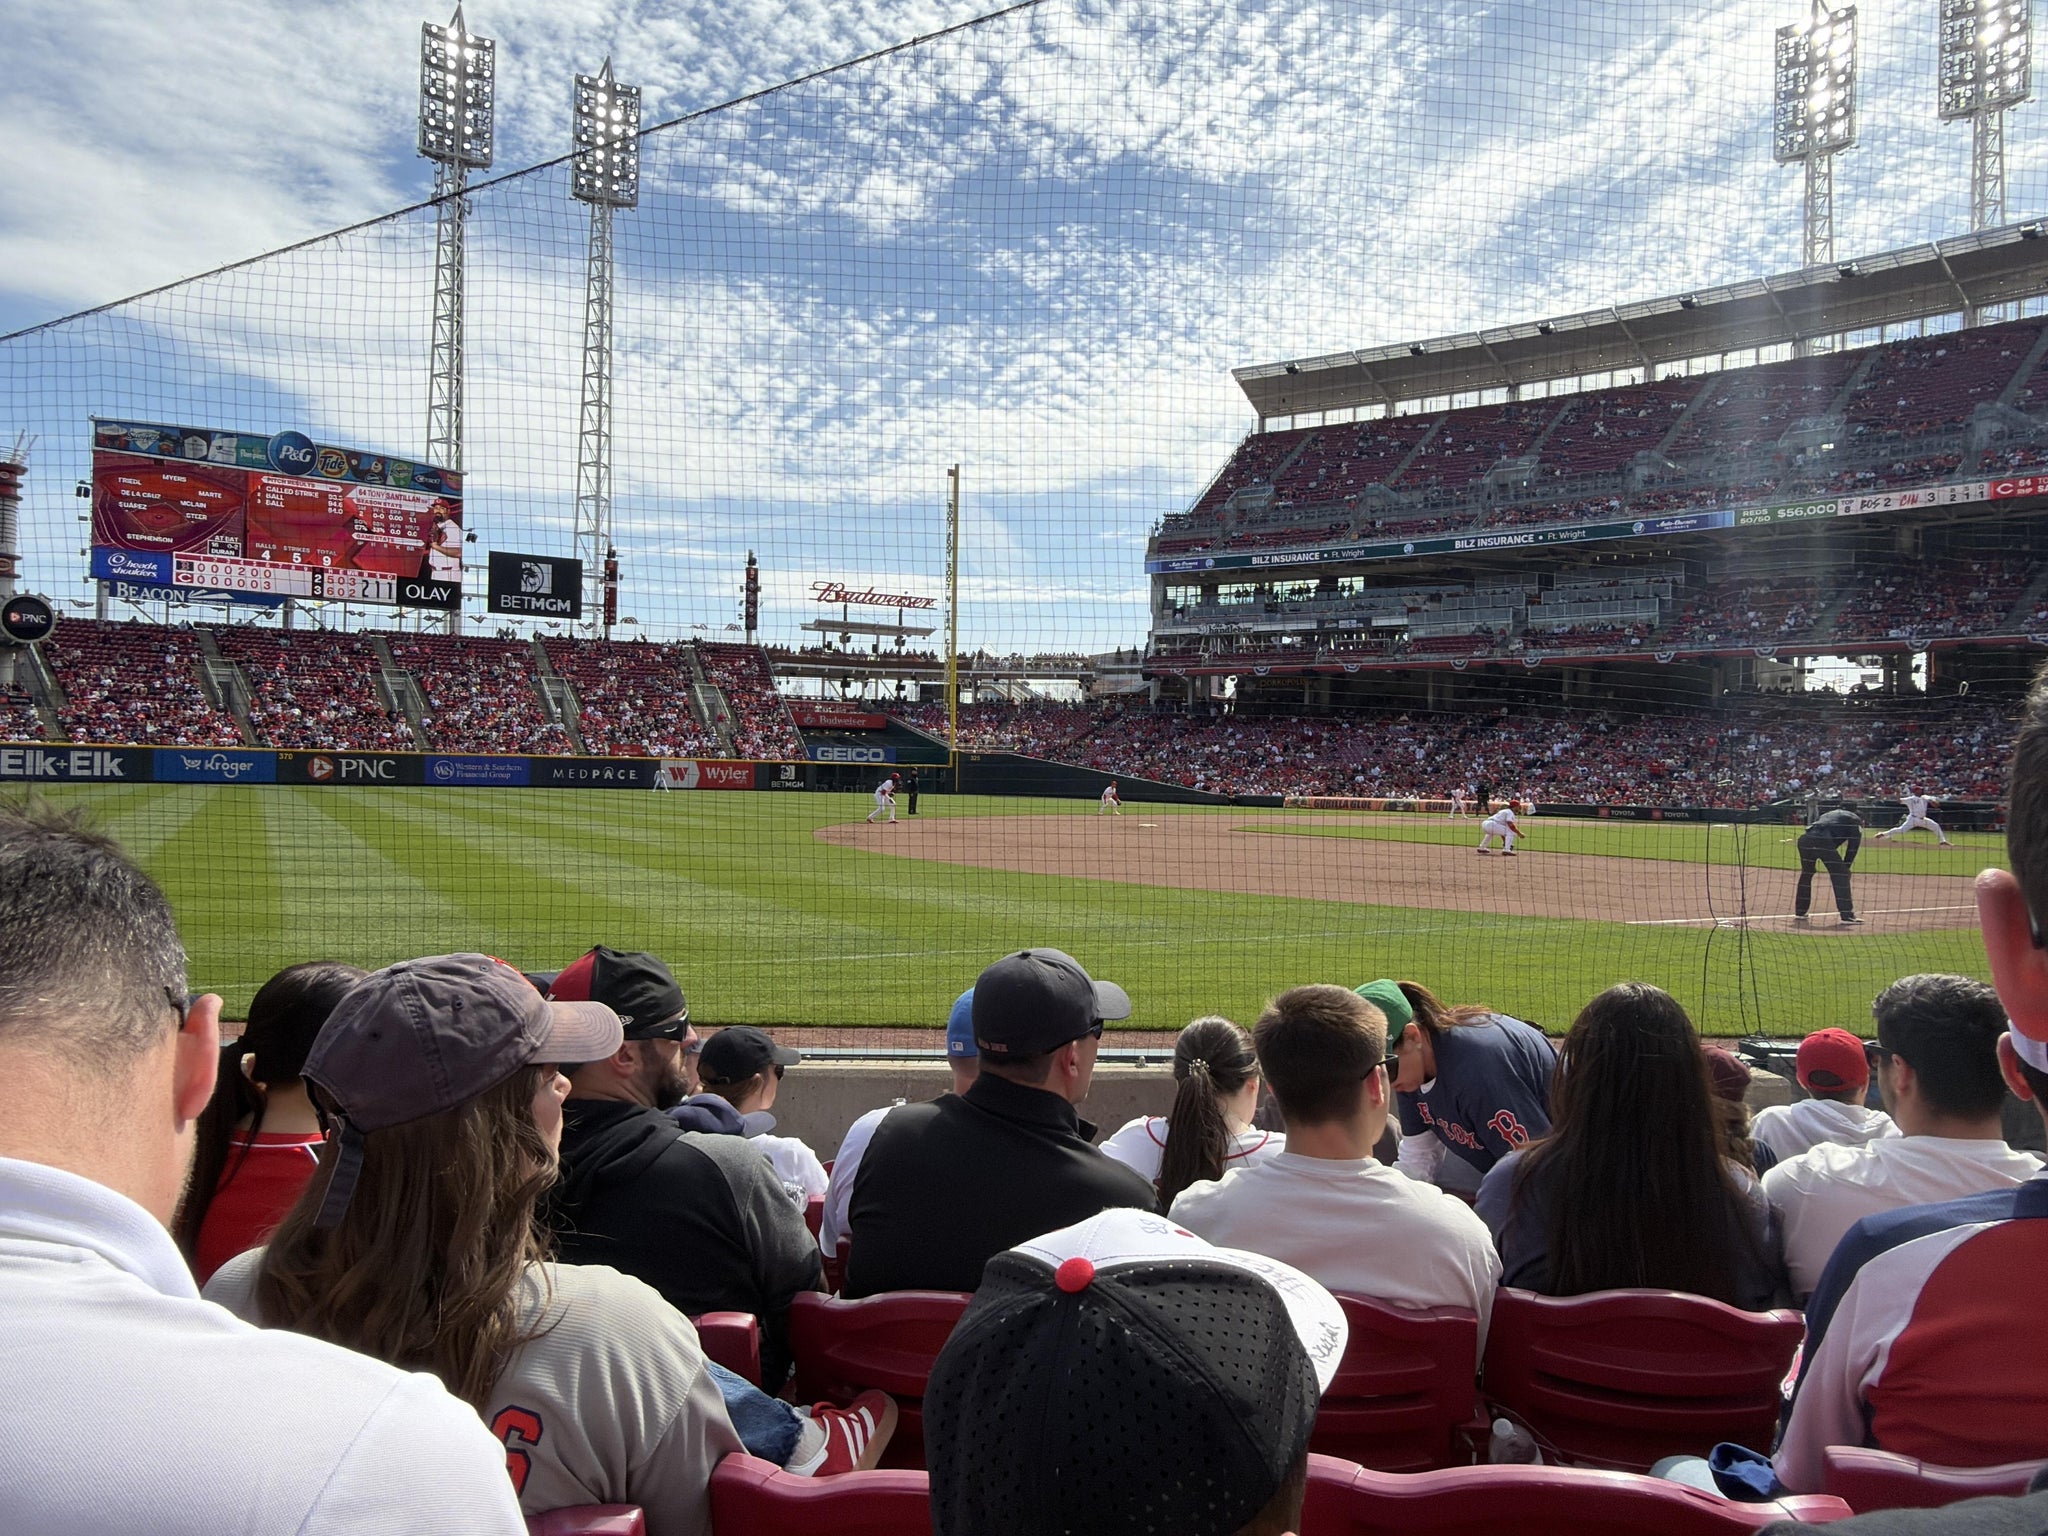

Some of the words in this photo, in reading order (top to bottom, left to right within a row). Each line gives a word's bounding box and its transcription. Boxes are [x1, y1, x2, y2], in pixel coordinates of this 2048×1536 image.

[279, 445, 313, 462] P&G
[320, 456, 345, 471] Tide
[162, 474, 187, 482] MYERS
[142, 492, 161, 500] CRUZ
[198, 490, 222, 499] MARTE
[266, 486, 294, 495] CALLED
[294, 490, 319, 498] STRIKE
[368, 490, 385, 498] TONY
[386, 492, 420, 504] SANTILLAN
[1950, 494, 1956, 502] 2
[1964, 492, 1970, 500] 1
[1980, 490, 1984, 498] 1
[266, 500, 284, 508] BALL
[1884, 498, 1892, 507] 2
[1900, 494, 1919, 506] CIN
[1928, 492, 1936, 502] 3
[1742, 508, 1768, 517] REDS
[1777, 504, 1836, 518] $56,000
[1844, 506, 1850, 514] 8
[1740, 516, 1771, 524] 50/50
[126, 533, 174, 543] STEPHENSON
[390, 528, 402, 536] 0.0
[1454, 540, 1476, 550] BILZ
[1477, 534, 1535, 548] INSURANCE
[1547, 532, 1557, 540] Ft.
[1560, 530, 1586, 540] Wright
[211, 548, 235, 556] DURAN
[261, 550, 271, 560] 4
[283, 546, 310, 554] STRIKES
[292, 552, 302, 563] 5
[322, 556, 332, 566] 9
[1252, 556, 1270, 564] BILZ
[1271, 552, 1320, 564] INSURANCE
[1342, 550, 1365, 558] Wright
[112, 566, 158, 578] shoulders
[198, 563, 206, 572] 0
[211, 564, 219, 574] 0
[224, 566, 232, 575] 0
[238, 567, 246, 576] 2
[250, 568, 258, 577] 0
[264, 569, 272, 578] 0
[314, 574, 322, 584] 2
[327, 576, 334, 584] 5
[338, 576, 345, 586] 0
[348, 577, 356, 587] 3
[116, 581, 186, 602] BEACON
[197, 575, 205, 584] 0
[210, 576, 218, 586] 0
[224, 577, 232, 586] 0
[238, 578, 246, 588] 0
[250, 580, 258, 589] 0
[264, 581, 271, 590] 3
[314, 585, 322, 595] 3
[326, 586, 334, 596] 6
[338, 588, 345, 597] 0
[348, 588, 356, 598] 2
[362, 580, 369, 598] 2
[376, 581, 380, 599] 1
[387, 582, 392, 600] 1
[406, 584, 452, 601] OLAY
[812, 581, 935, 609] Budweiser
[500, 594, 571, 613] BETMGM
[22, 612, 46, 624] PNC
[820, 715, 866, 726] Budweiser
[816, 746, 884, 762] GEICO
[204, 754, 254, 778] Kroger
[338, 758, 396, 779] PNC
[489, 771, 511, 780] Group
[552, 766, 638, 780] MEDPACE
[705, 766, 749, 784] Wyler
[1350, 800, 1372, 810] GLUE
[1487, 1109, 1530, 1152] B
